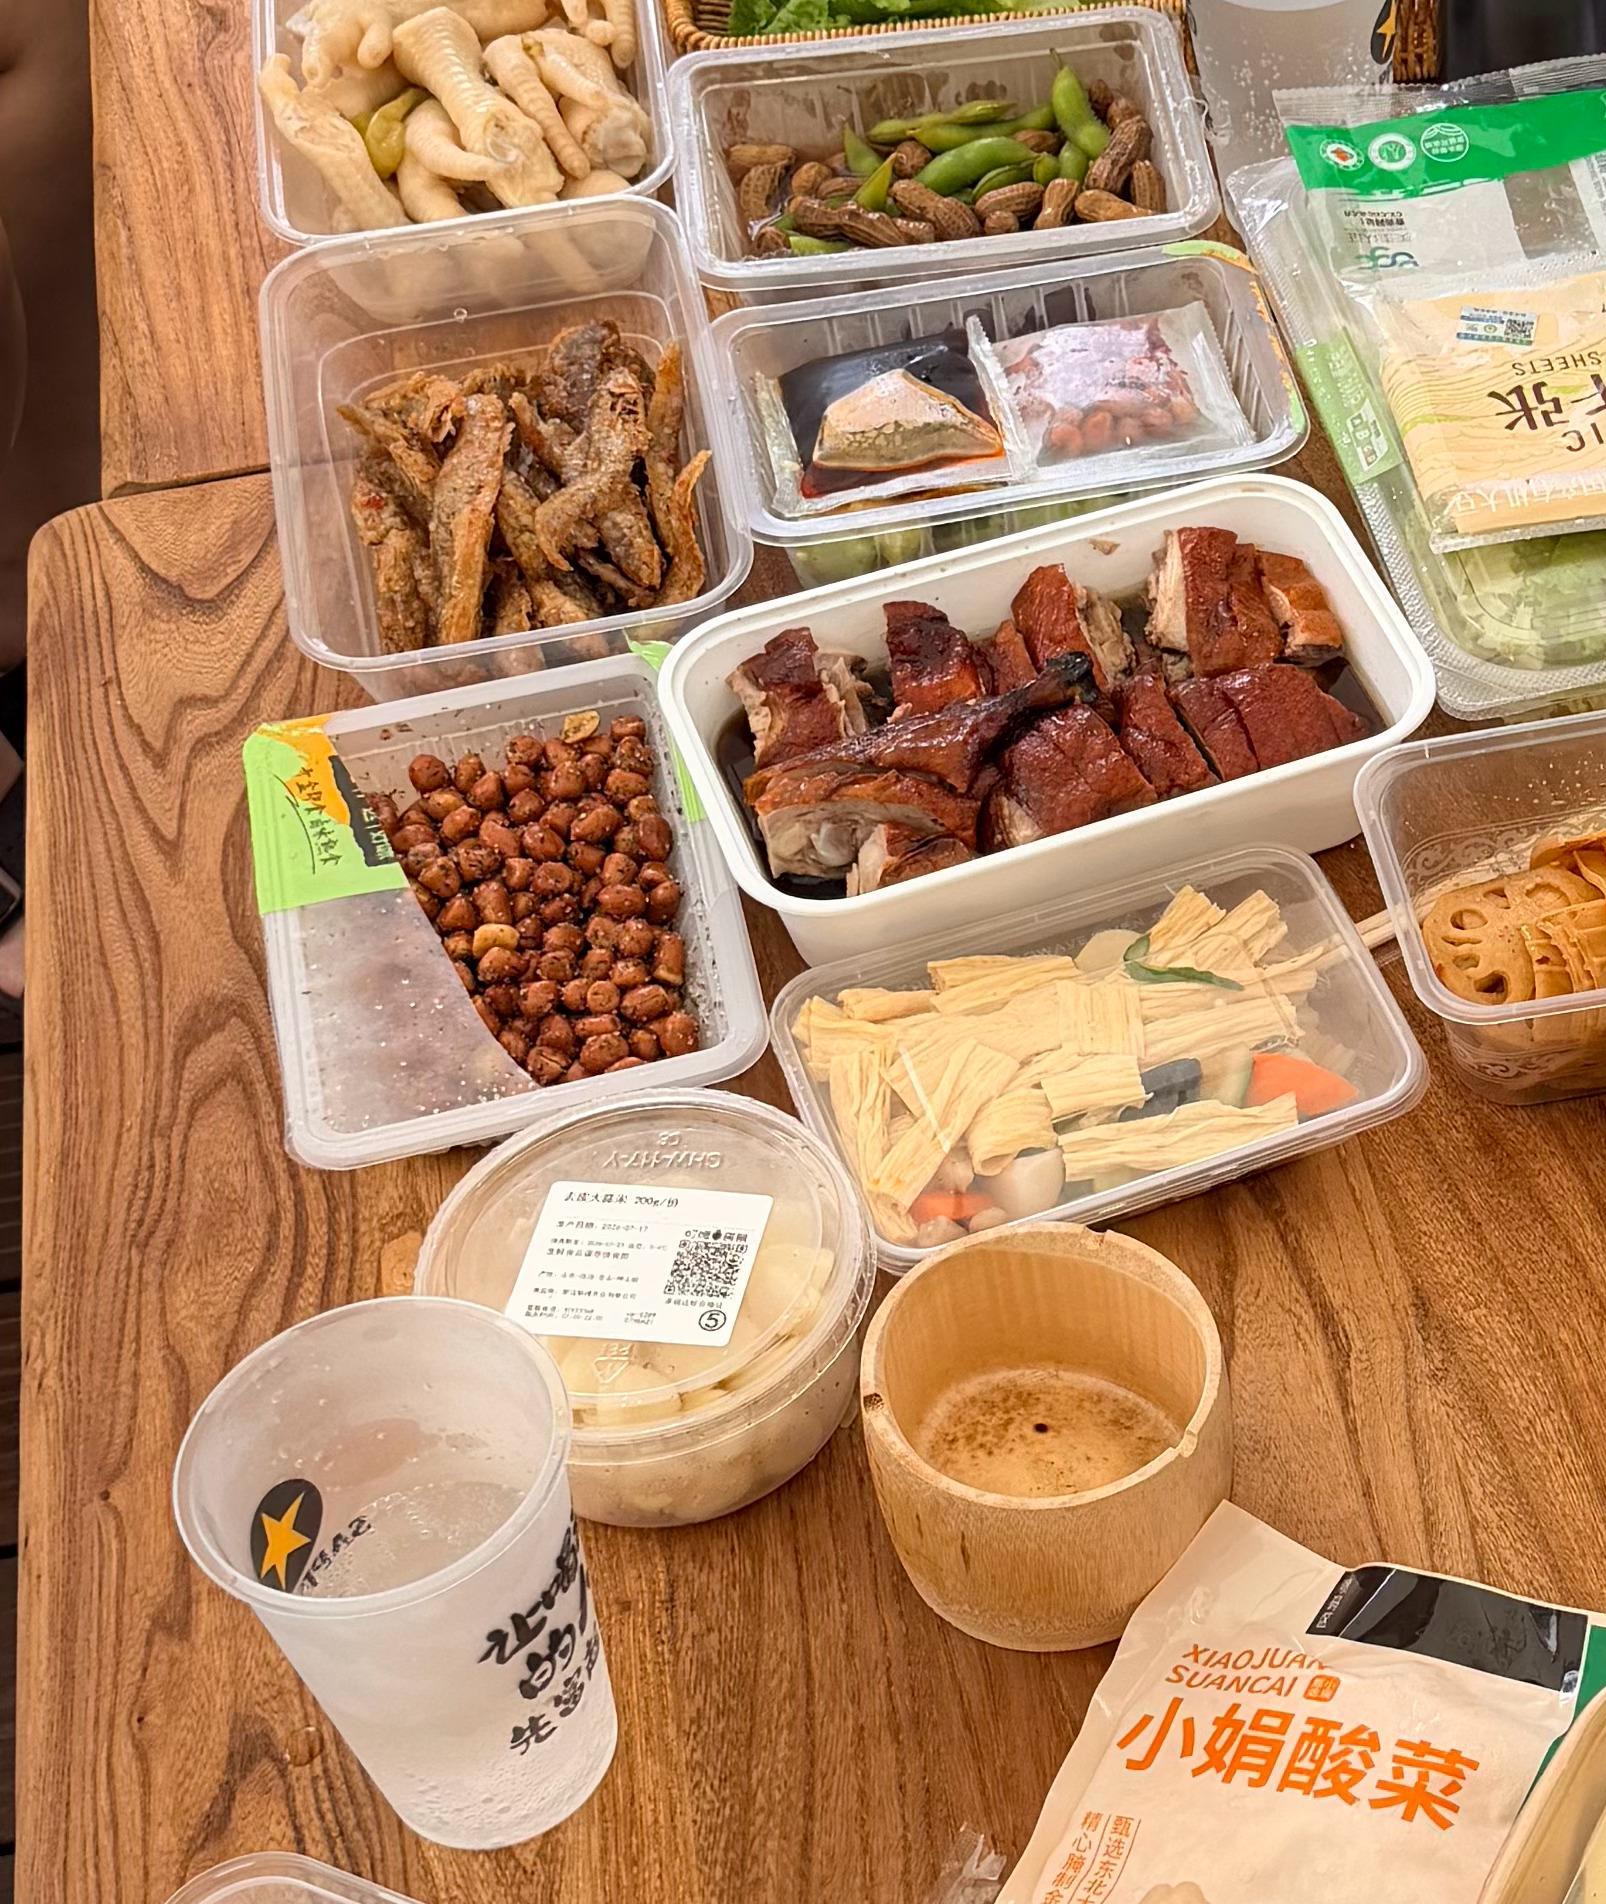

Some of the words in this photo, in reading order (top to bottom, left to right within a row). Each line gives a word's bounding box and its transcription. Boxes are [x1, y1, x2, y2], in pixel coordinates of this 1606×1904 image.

[1511, 351, 1605, 377] SHEETS
[1165, 1664, 1298, 1697] SUANCAI
[1116, 1697, 1480, 1831] 小娟酸菜
